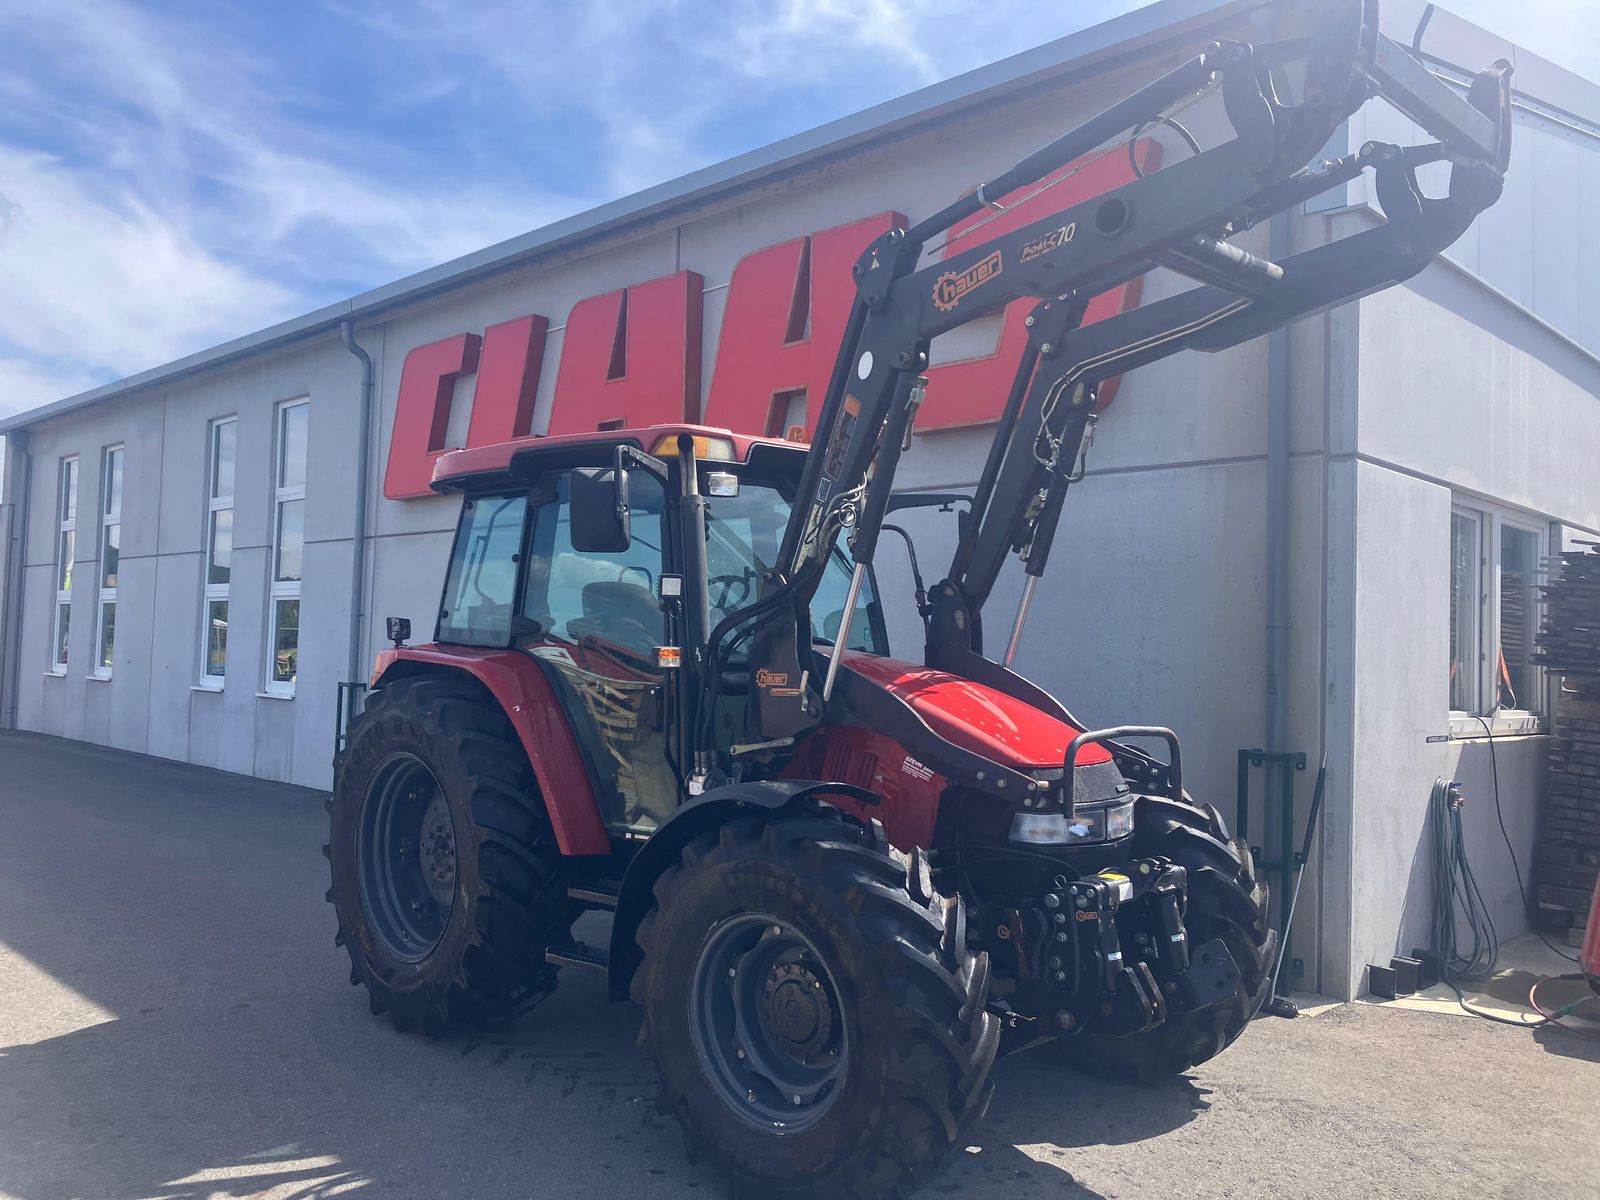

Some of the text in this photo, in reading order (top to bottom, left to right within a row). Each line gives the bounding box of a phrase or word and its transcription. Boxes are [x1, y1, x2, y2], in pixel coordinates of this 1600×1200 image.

[1057, 222, 1077, 247] 70
[941, 255, 1000, 303] hauer
[904, 755, 924, 769] STEYR
